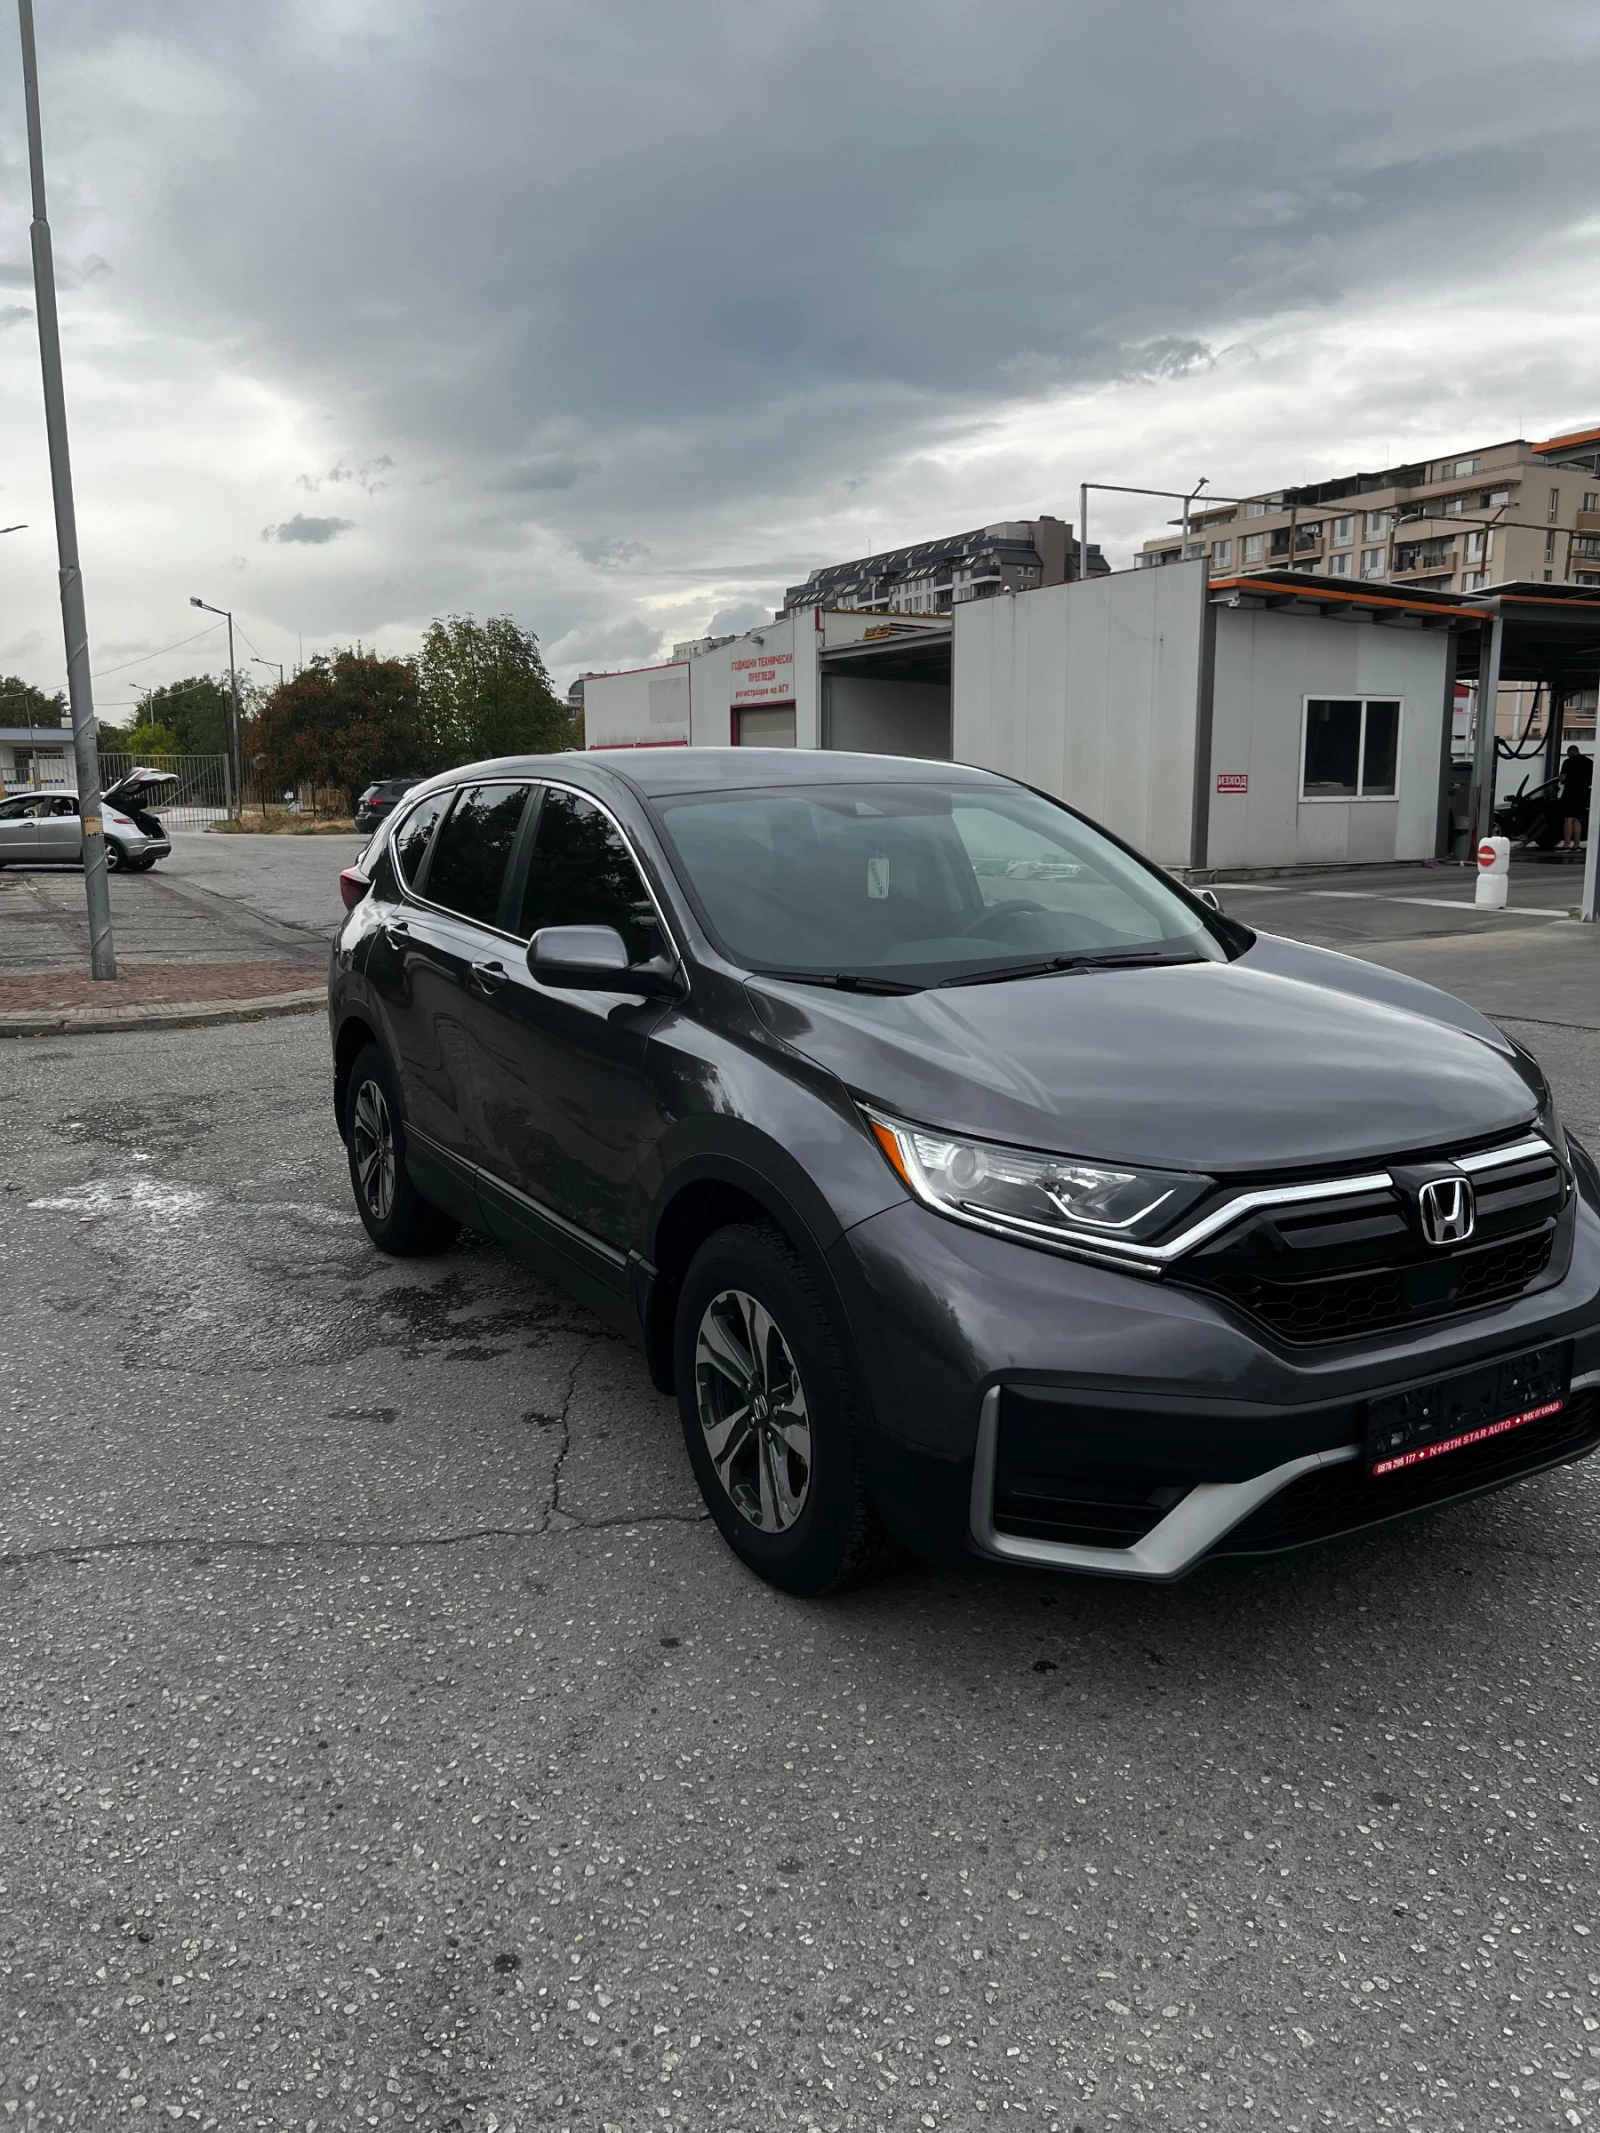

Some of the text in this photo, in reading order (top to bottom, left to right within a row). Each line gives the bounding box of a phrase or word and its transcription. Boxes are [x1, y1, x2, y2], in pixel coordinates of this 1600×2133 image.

[731, 653, 793, 672] ГОДИШНИ ТЕХНИЧЕСКИ
[748, 670, 776, 682] ПРЕГЛЕДИ
[736, 688, 769, 699] регистрация
[778, 683, 789, 693] АГУ
[1218, 775, 1247, 787] ИЗХОД
[1405, 1453, 1416, 1465] 177
[1463, 1428, 1487, 1445] STAR
[1487, 1420, 1511, 1436] AUTO
